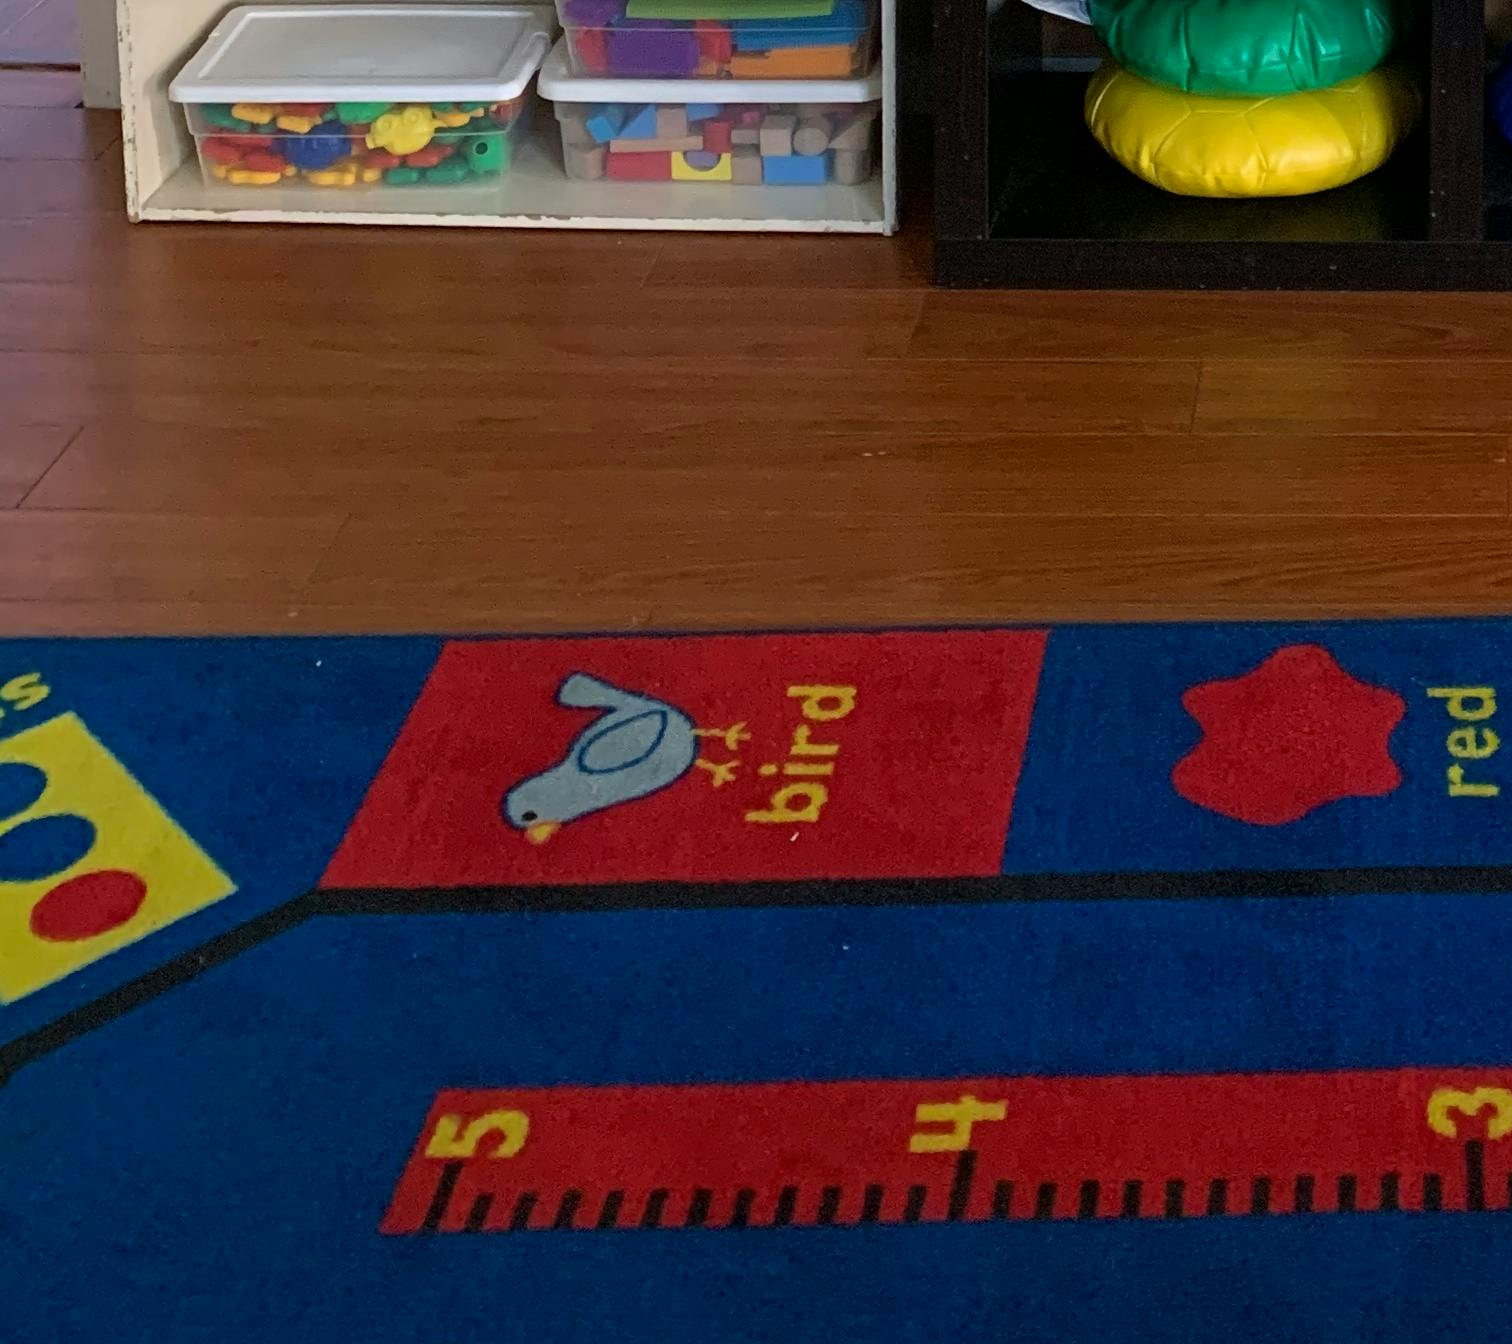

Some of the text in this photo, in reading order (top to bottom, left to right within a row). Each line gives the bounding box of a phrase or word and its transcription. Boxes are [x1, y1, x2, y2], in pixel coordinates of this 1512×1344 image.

[746, 685, 857, 824] bird
[1427, 686, 1499, 798] red
[426, 1110, 527, 1159] 5
[911, 1097, 1007, 1153] 4
